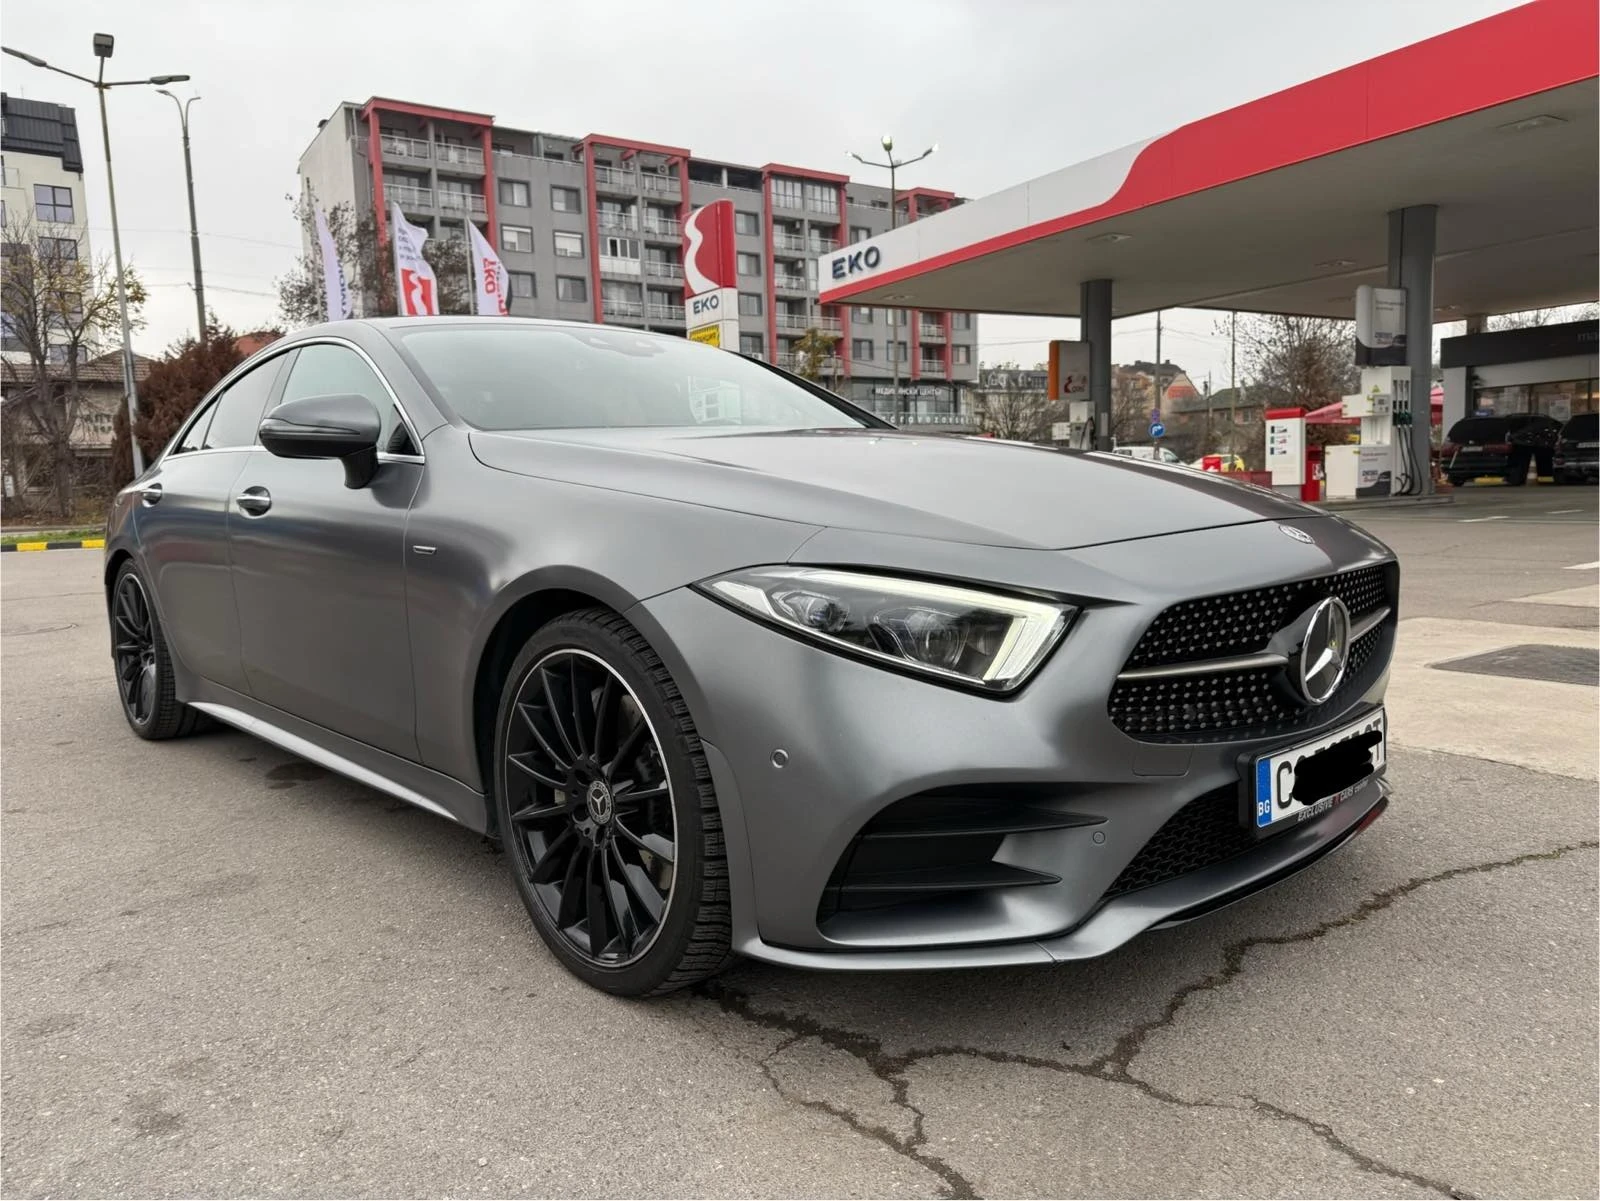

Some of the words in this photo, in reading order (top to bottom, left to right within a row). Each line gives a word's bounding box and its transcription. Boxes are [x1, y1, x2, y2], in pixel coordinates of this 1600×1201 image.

[832, 246, 881, 279] EKO
[693, 294, 720, 315] EKO
[1258, 799, 1271, 816] BG
[1297, 799, 1333, 821] EXCLUSIVE
